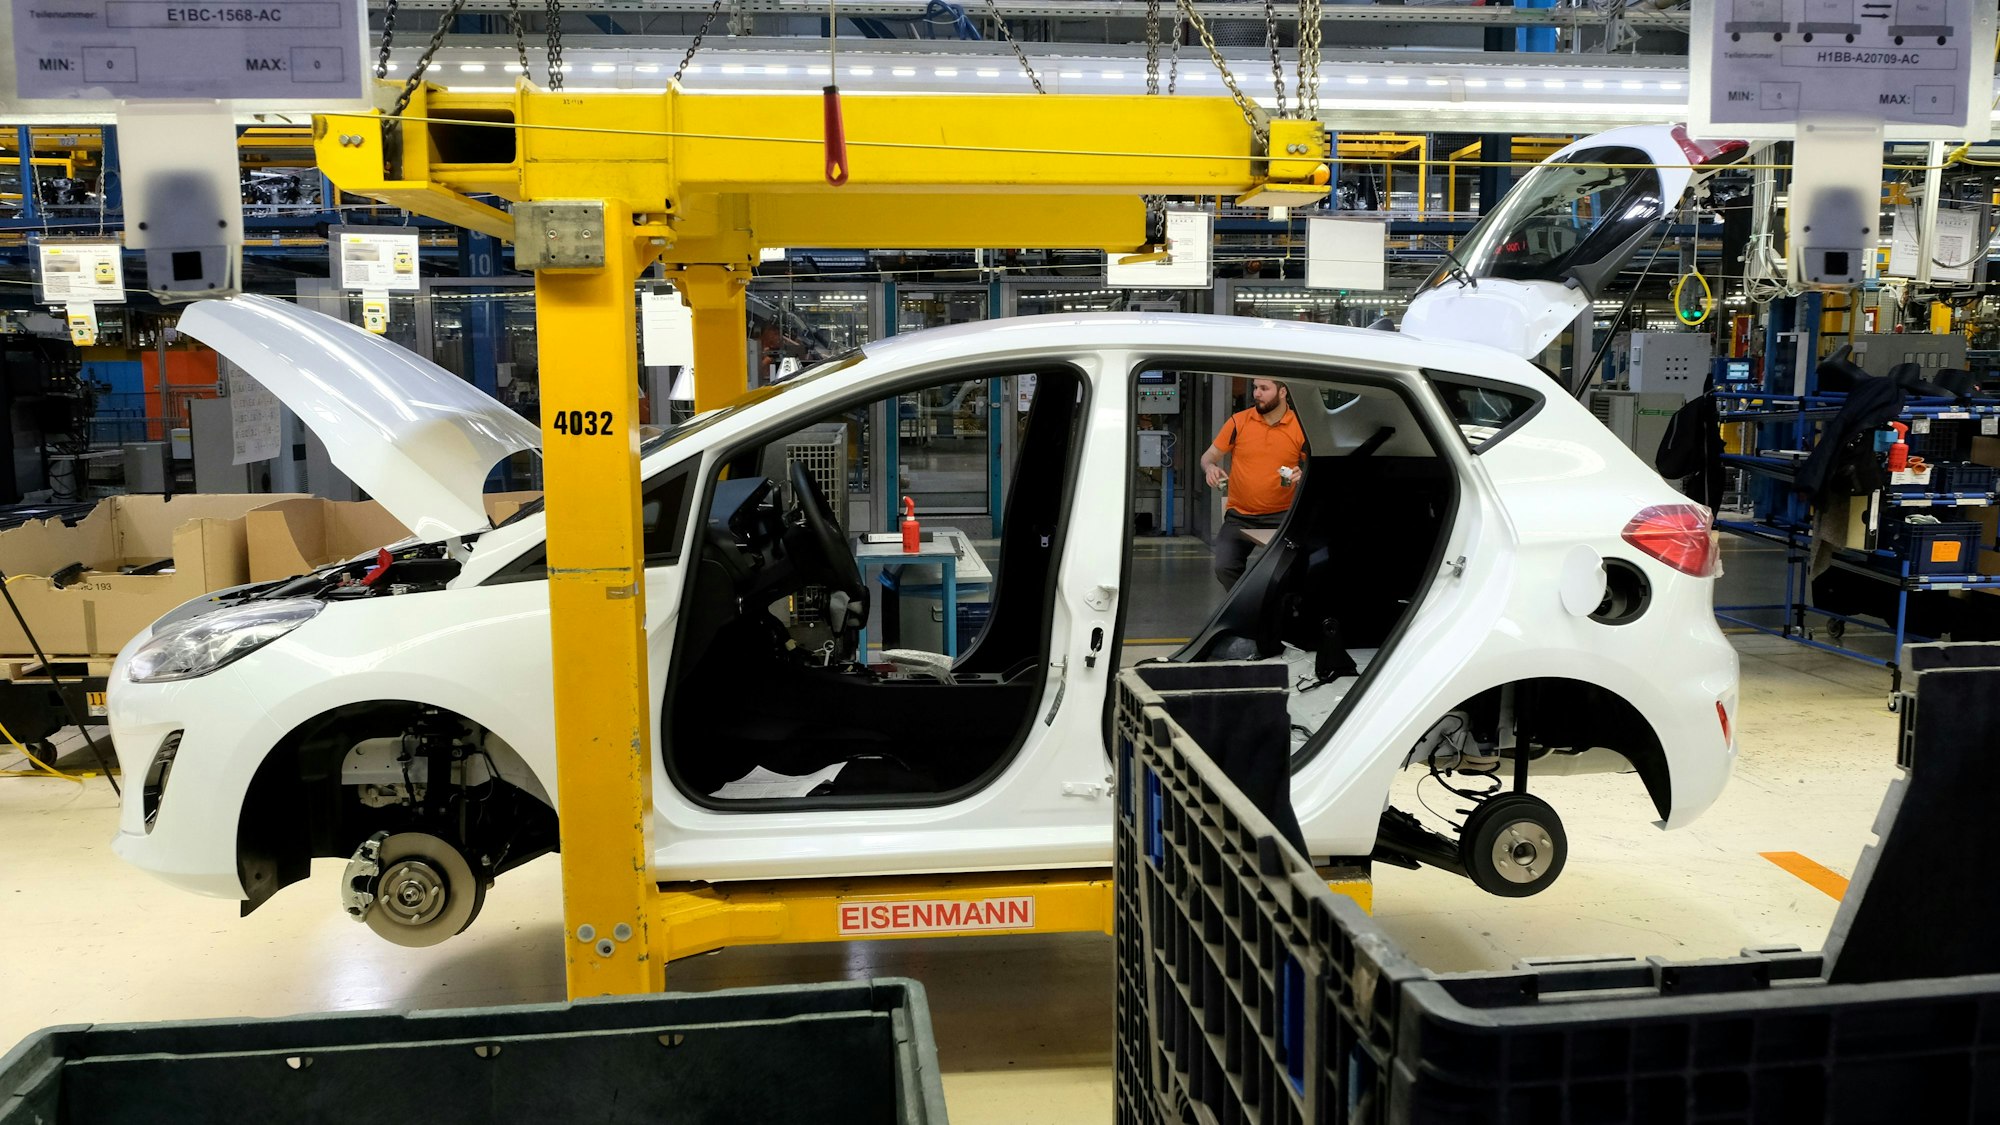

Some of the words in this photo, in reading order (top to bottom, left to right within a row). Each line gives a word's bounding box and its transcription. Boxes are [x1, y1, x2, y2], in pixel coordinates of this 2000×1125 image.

[168, 9, 281, 22] E1BC-1568-AC
[1817, 52, 1919, 64] H1BB-A20709-AC
[39, 58, 75, 71] MIN:
[106, 60, 113, 69] 0
[246, 59, 286, 71] MAX:
[314, 61, 321, 69] 0
[1728, 91, 1754, 101] MIN:
[1879, 94, 1910, 105] MAX:
[469, 254, 490, 275] 10
[554, 411, 613, 435] 4032
[96, 583, 112, 591] 193
[842, 901, 1028, 930] EISENMANN
